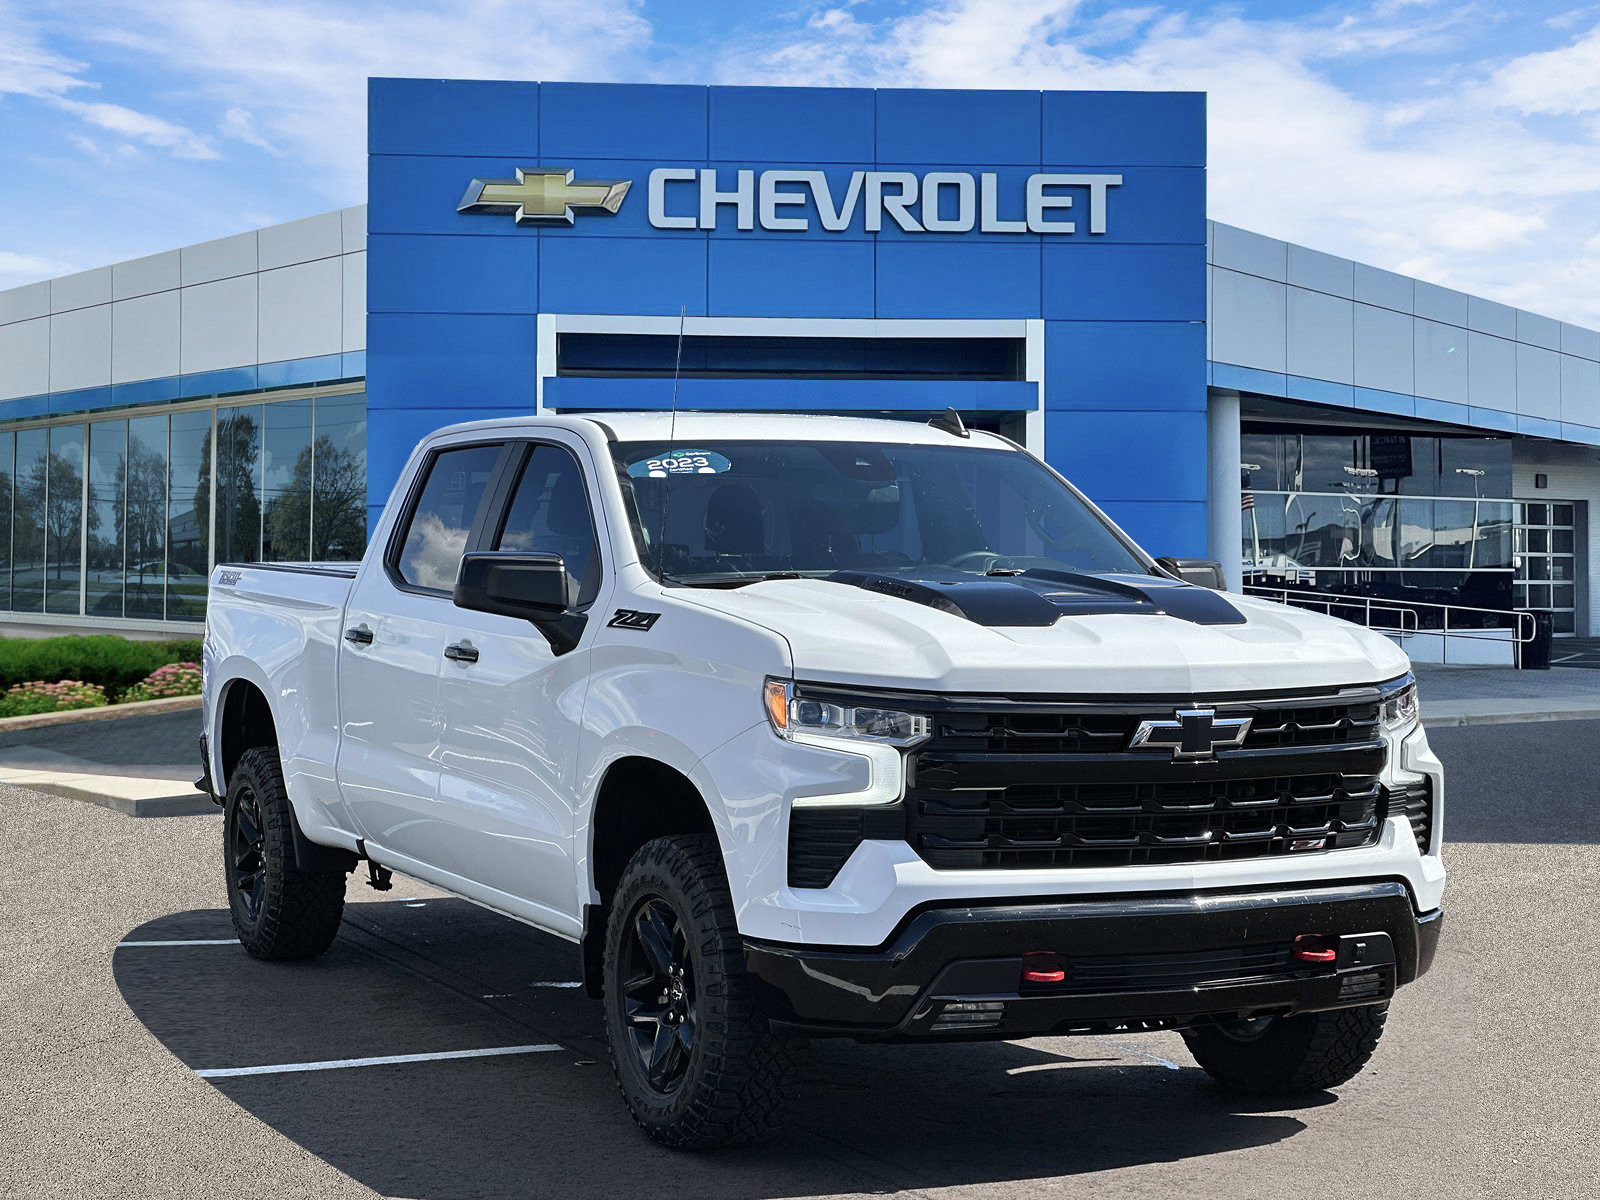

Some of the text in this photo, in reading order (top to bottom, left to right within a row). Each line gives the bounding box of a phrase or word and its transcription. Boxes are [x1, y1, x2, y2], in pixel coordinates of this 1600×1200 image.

[647, 167, 1123, 235] CHEVROLET
[646, 457, 709, 469] 2023
[220, 571, 242, 580] TRAIL
[218, 578, 238, 586] BOSS
[606, 609, 662, 632] Z71
